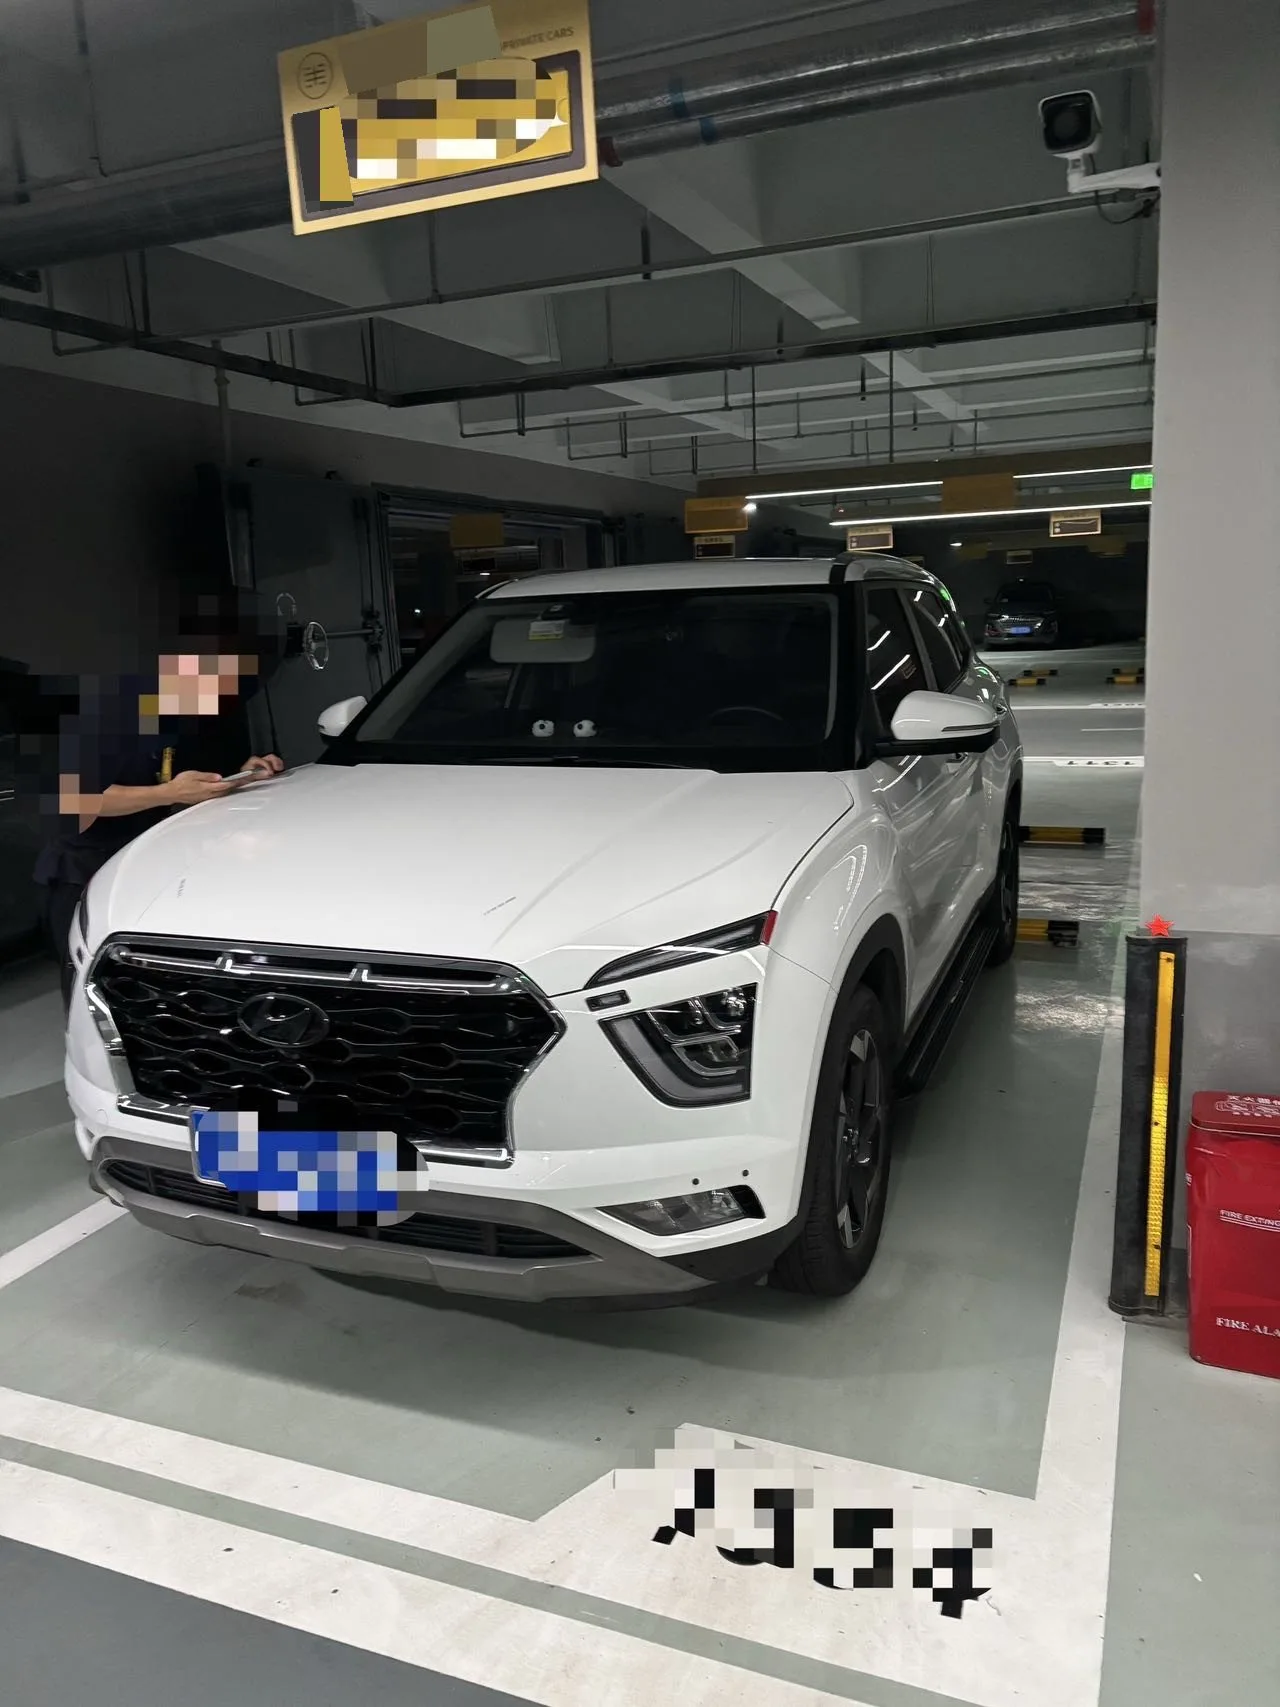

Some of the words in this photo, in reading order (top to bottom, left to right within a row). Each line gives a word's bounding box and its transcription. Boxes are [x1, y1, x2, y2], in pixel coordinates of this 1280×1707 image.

[546, 26, 574, 40] CARS
[1220, 1209, 1243, 1219] FIRE
[1216, 1317, 1250, 1331] FIRE
